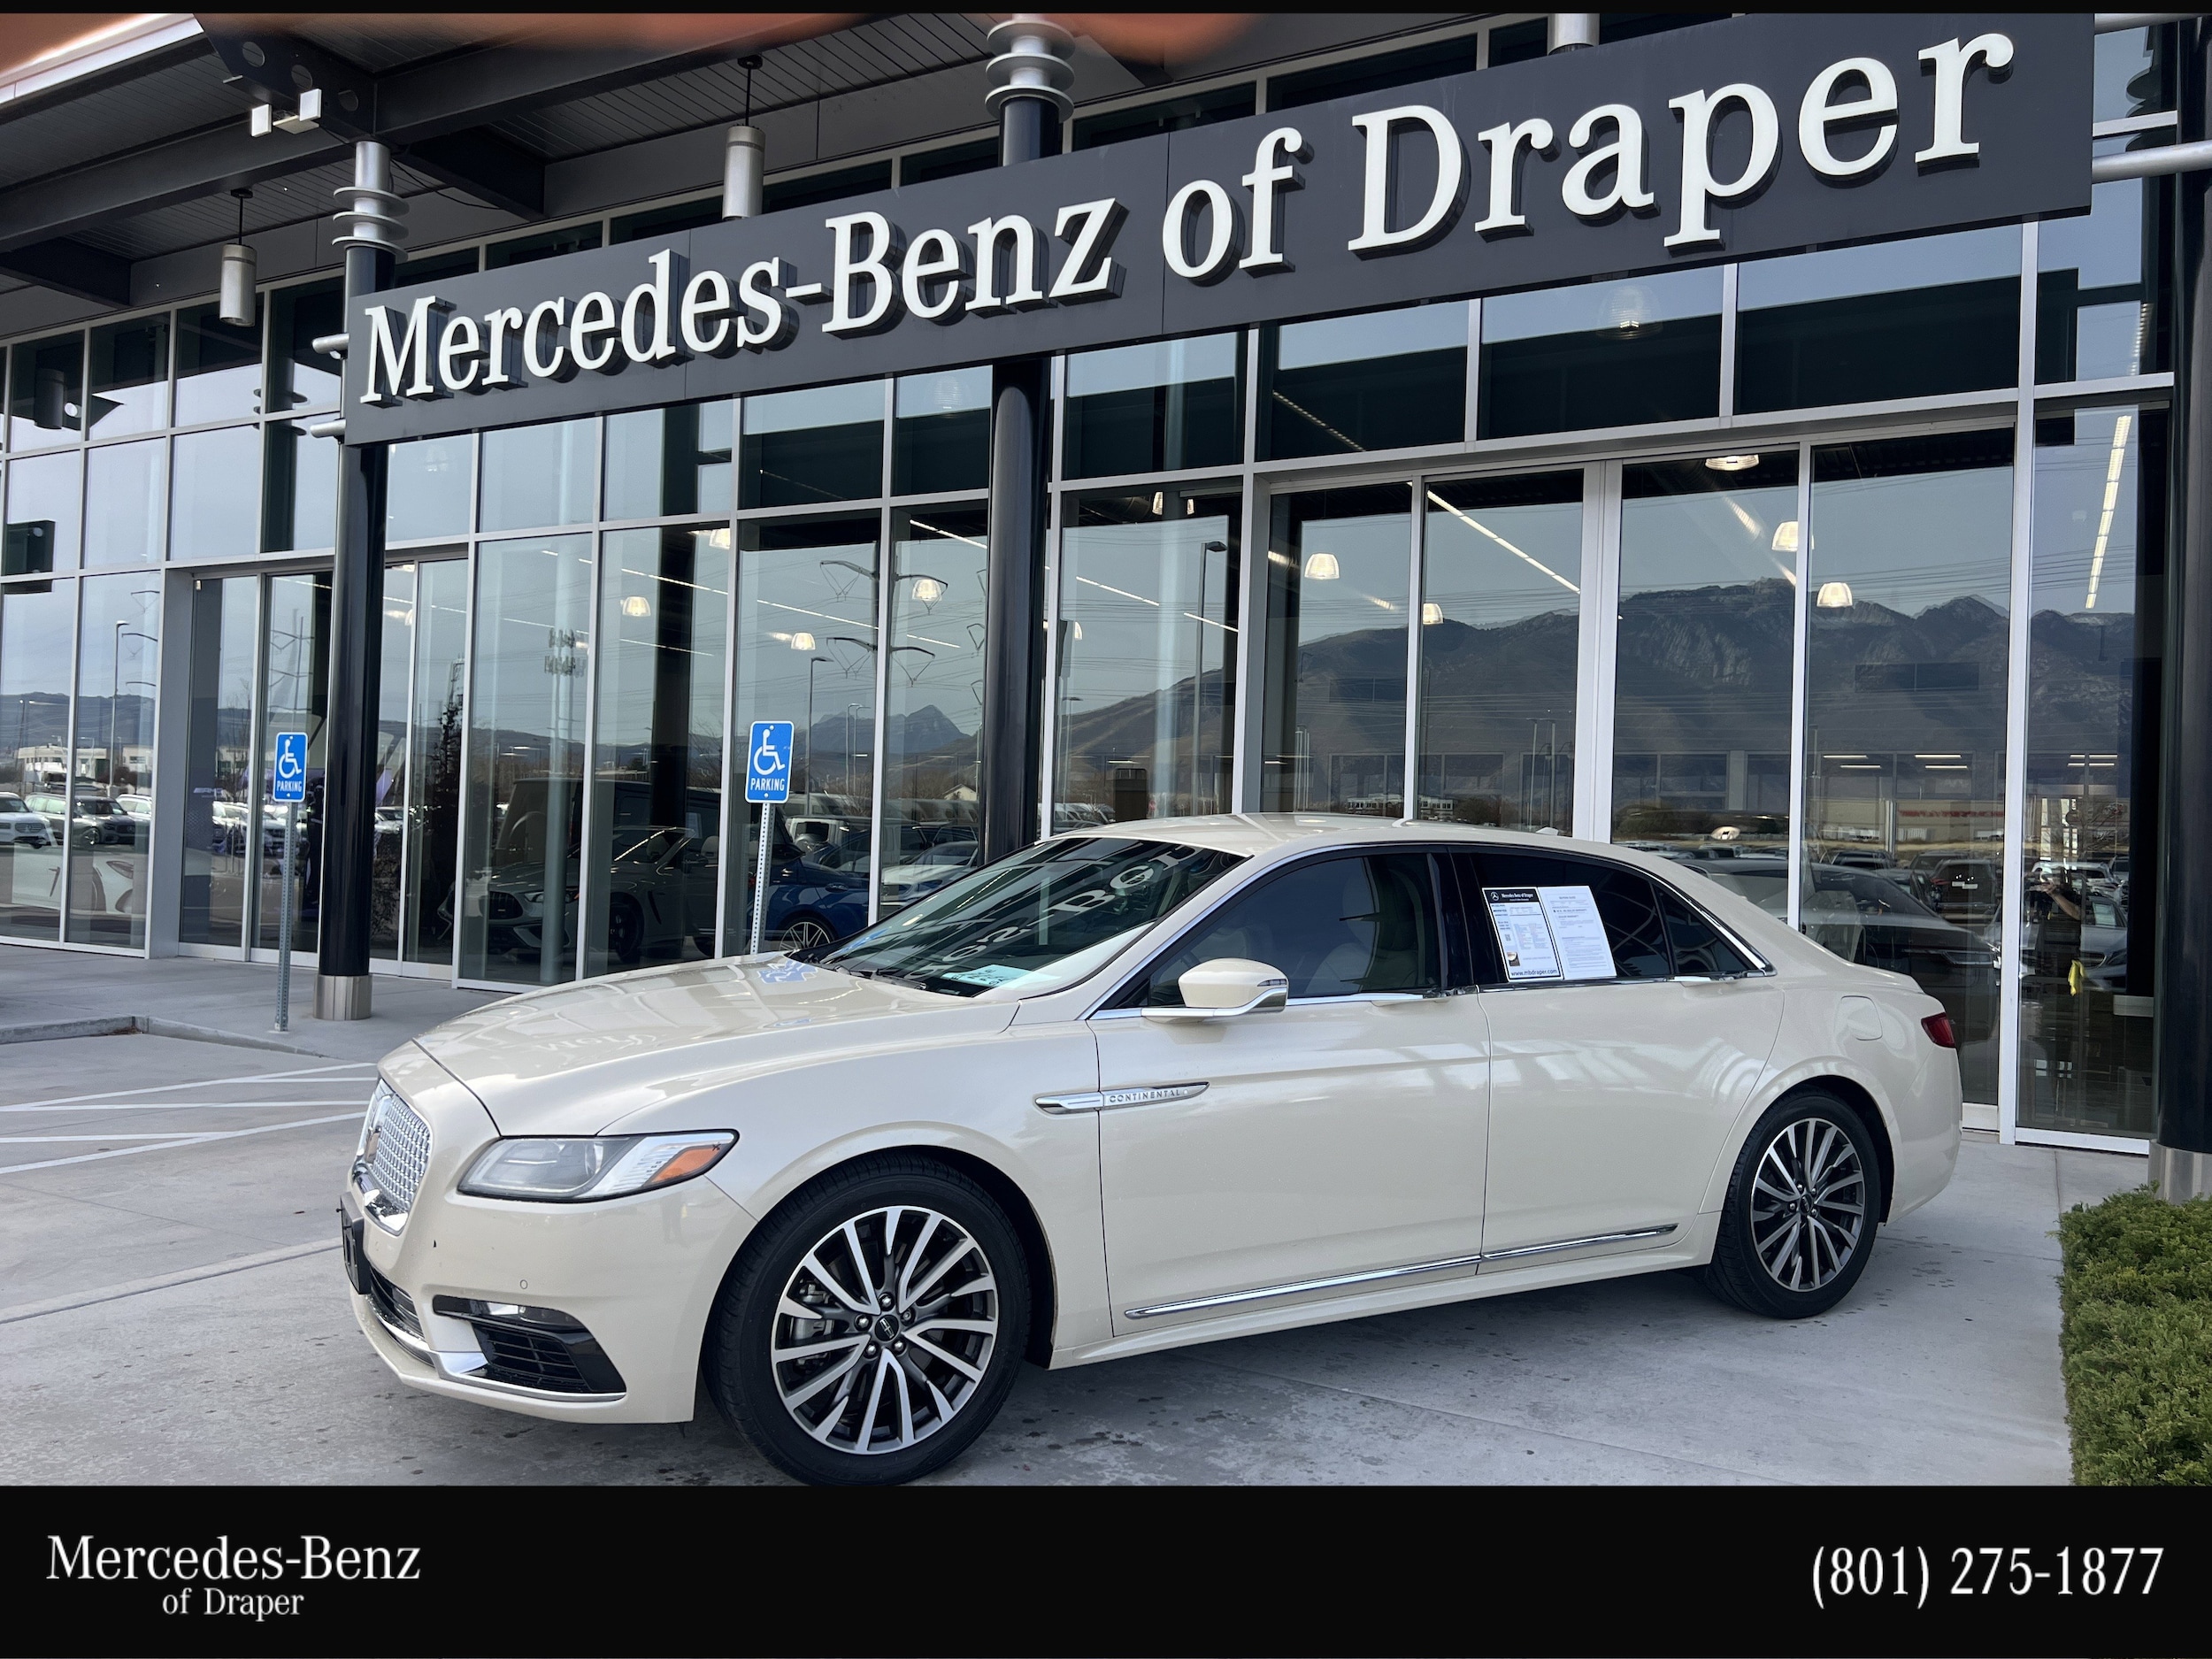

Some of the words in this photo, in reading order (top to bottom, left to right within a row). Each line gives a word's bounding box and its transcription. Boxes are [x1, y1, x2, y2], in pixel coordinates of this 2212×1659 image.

[359, 196, 1117, 404] Mercedes-Benz
[1162, 127, 1303, 279] of
[1348, 33, 2015, 252] Draper
[276, 780, 303, 792] PARKING
[749, 777, 786, 791] PARKING
[1109, 1089, 1181, 1103] CONTINENTAL
